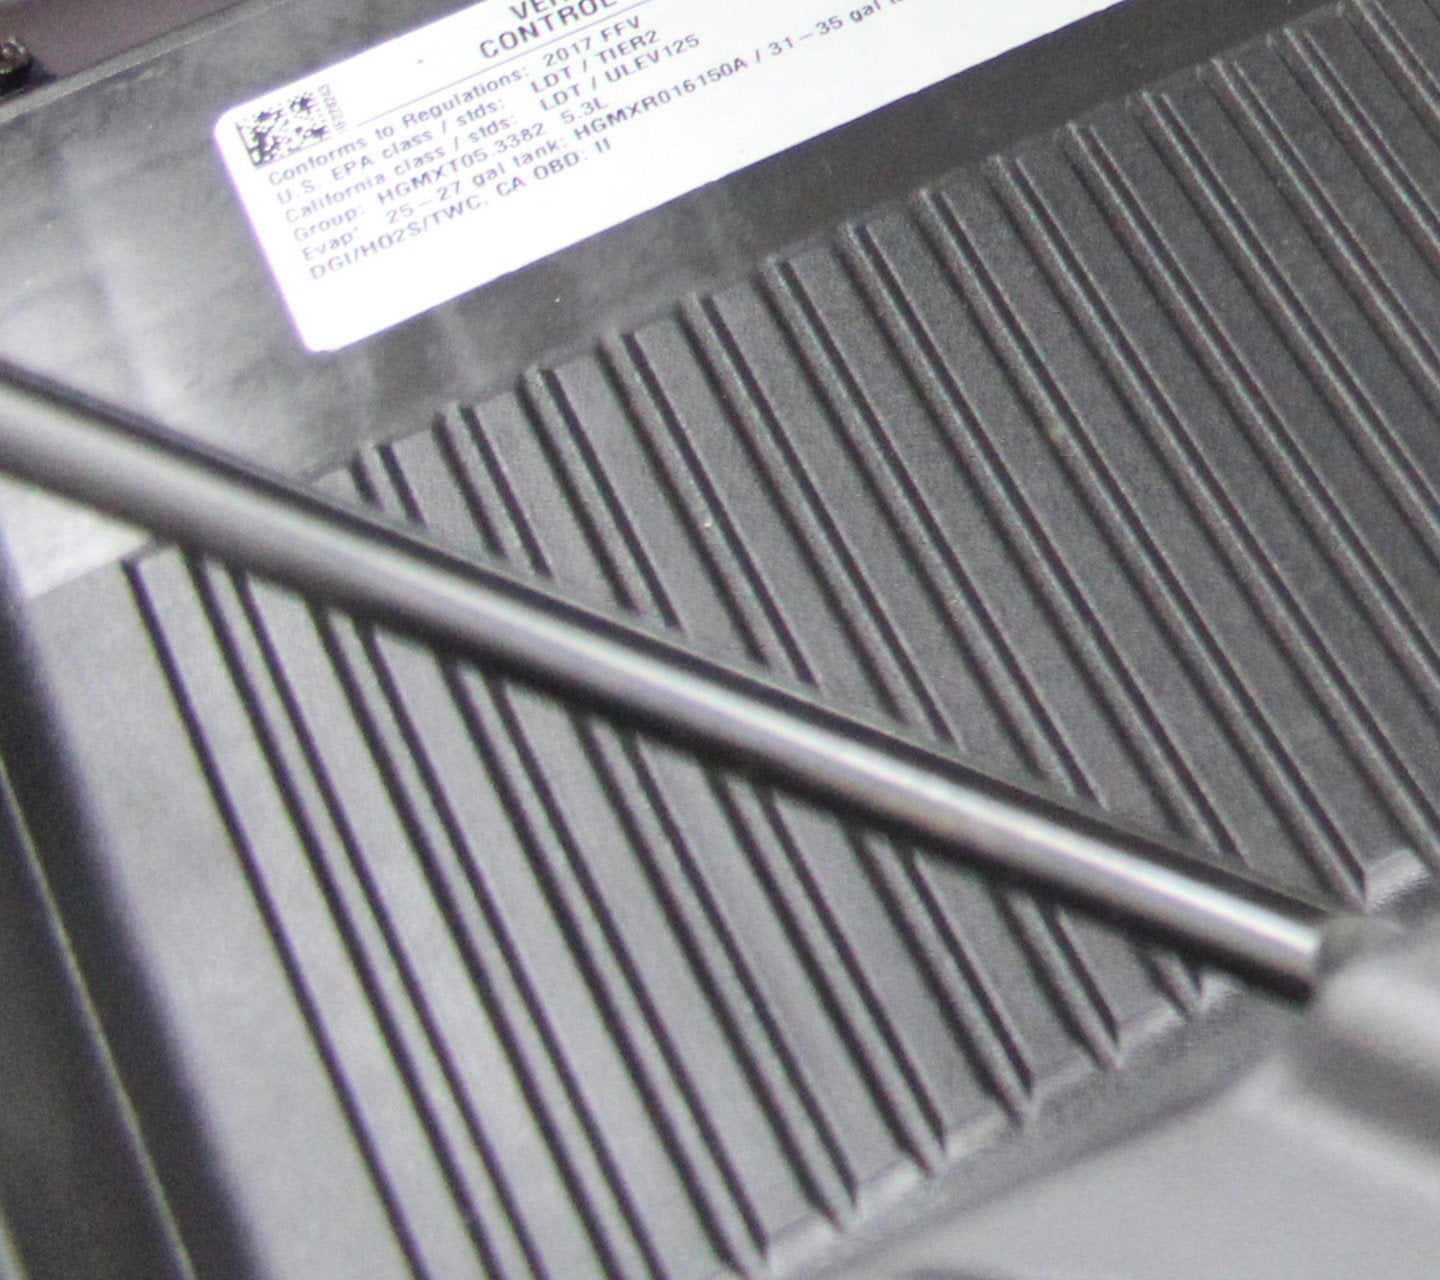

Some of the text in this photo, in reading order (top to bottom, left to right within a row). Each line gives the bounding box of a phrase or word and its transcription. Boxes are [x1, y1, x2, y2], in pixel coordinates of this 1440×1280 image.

[268, 15, 640, 186] Conforms to Regulations: 2017 FFV
[276, 178, 316, 205] U.S.
[330, 154, 374, 181] EPA
[381, 130, 433, 159] class
[456, 102, 498, 126] stds:
[530, 65, 571, 94] LDT
[597, 30, 657, 64] TIER2
[285, 173, 386, 222] California
[393, 146, 446, 176] class
[468, 118, 510, 143] stds:
[539, 83, 581, 112] LDT
[604, 34, 700, 83] ULEV125
[293, 97, 607, 242] Group: HGMXT05.3382 5.3L
[471, 161, 506, 188] gal
[512, 140, 559, 168] tank:
[574, 57, 748, 140] HGMXR016150A
[495, 176, 526, 196] CA
[532, 151, 580, 180] OBD:
[594, 137, 611, 153] II
